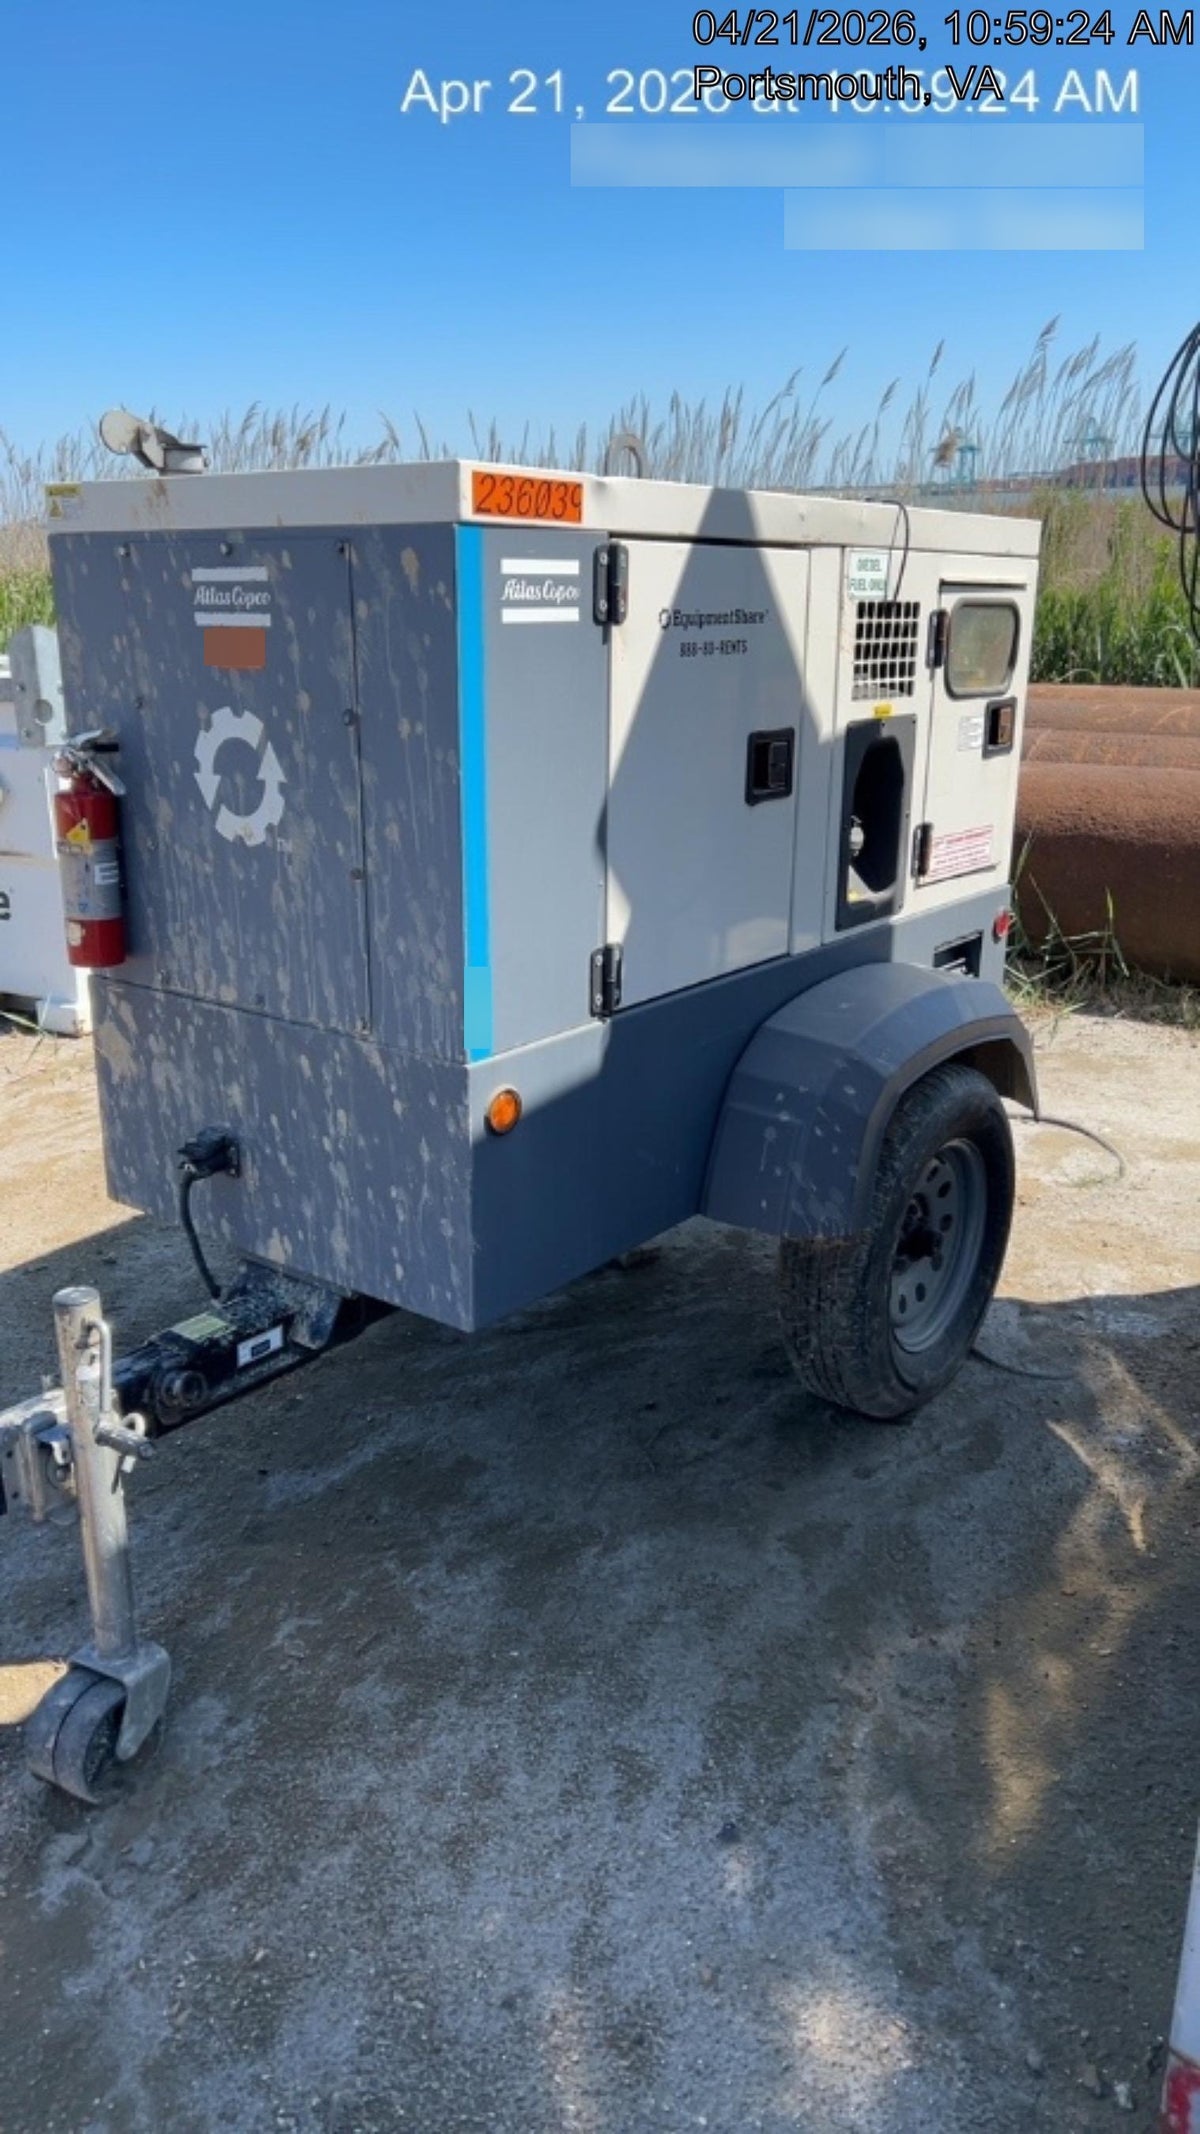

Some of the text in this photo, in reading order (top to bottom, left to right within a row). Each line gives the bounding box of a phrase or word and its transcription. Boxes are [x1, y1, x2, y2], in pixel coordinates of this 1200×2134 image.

[475, 474, 582, 523] 236039
[194, 585, 271, 610] Atlas Copco
[502, 579, 580, 604] Atlas Copco
[672, 608, 766, 630] EquipmentShare
